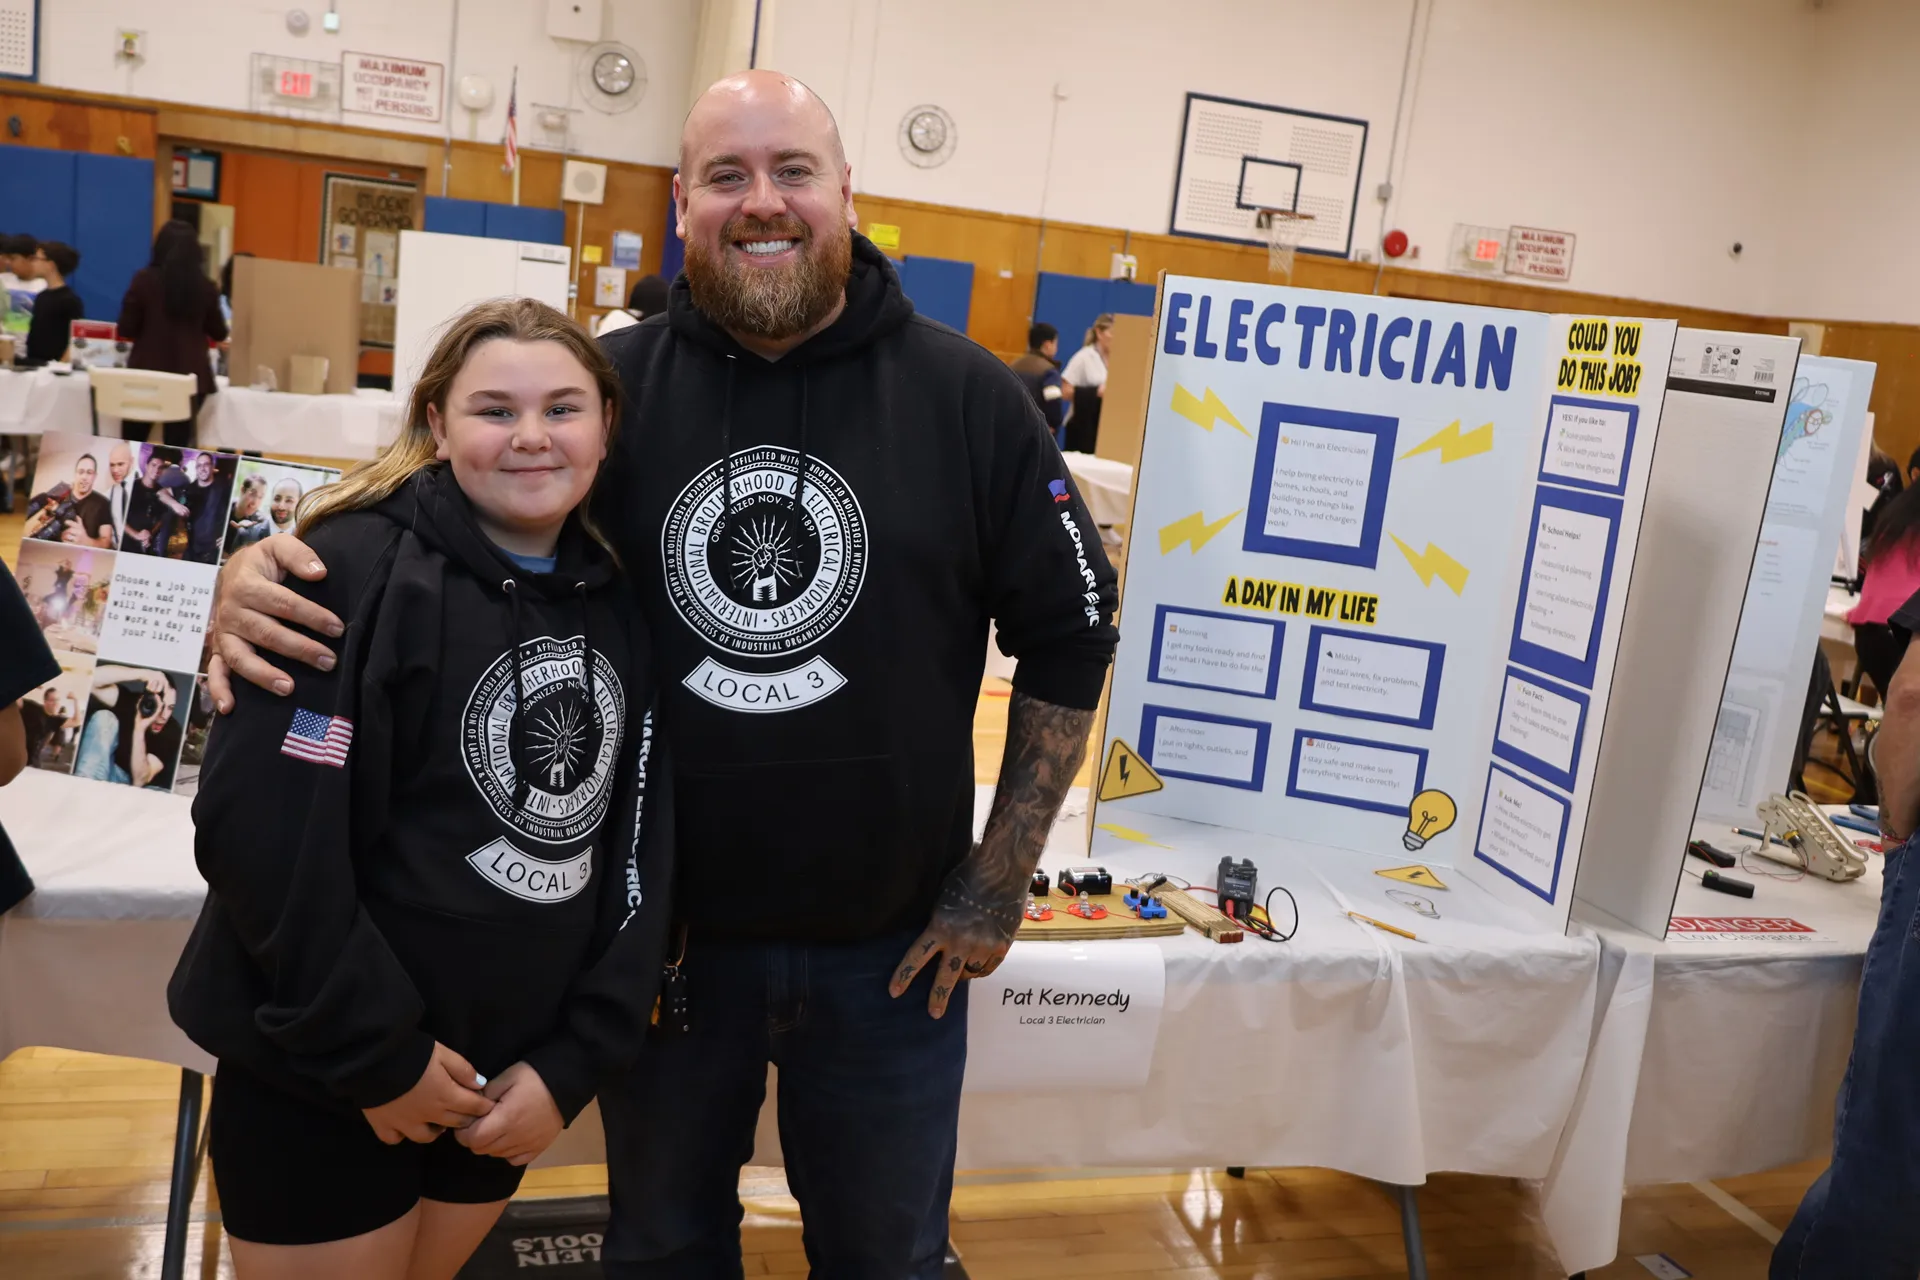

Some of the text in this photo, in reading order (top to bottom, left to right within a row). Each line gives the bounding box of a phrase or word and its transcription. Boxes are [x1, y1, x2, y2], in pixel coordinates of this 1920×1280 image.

[359, 59, 426, 77] MAXIMUM
[281, 71, 312, 97] EXIT
[353, 72, 430, 92] OCCUPANCY
[375, 99, 433, 117] PERSONS
[1163, 291, 1518, 392] ELECTRICIAN
[1568, 322, 1640, 356] COULD YOU
[1558, 359, 1640, 394] DO THIS JOB?
[730, 451, 800, 469] AFFILIATED WITH
[808, 463, 837, 487] LABOUR
[1279, 467, 1296, 478] help
[1298, 470, 1317, 481] bring
[1318, 474, 1355, 487] electricity
[1356, 478, 1364, 486] to
[683, 470, 717, 504] AMERICAN
[834, 486, 846, 497] OF
[1273, 480, 1348, 497] homes, schools, and
[1271, 493, 1305, 505] buildings
[1316, 500, 1339, 511] things
[1341, 502, 1354, 511] like
[758, 494, 783, 505] NOV.
[801, 514, 817, 537] 1891
[841, 497, 862, 548] FEDERATION
[1309, 512, 1324, 520] and
[1325, 514, 1357, 525] chargers
[667, 505, 686, 555] FEDERATION
[806, 493, 840, 572] ELECTRICAL
[667, 558, 675, 568] OF
[844, 552, 862, 595] CANADIAN
[115, 574, 149, 586] Choose
[168, 582, 185, 591] job
[191, 586, 210, 595] you
[669, 572, 684, 598] LABOR
[688, 541, 758, 628] INTERNATIONAL
[113, 600, 202, 620] will never have
[156, 594, 174, 602] and
[180, 597, 198, 606] you
[771, 578, 832, 628] WORKERS
[1225, 578, 1378, 623] A DAY IN MY LIFE
[108, 612, 119, 620] to
[125, 615, 148, 624] work
[166, 620, 184, 632] day
[191, 624, 202, 633] in
[122, 628, 146, 636] your
[685, 606, 718, 638] CONGRESS
[785, 604, 843, 648] ORGANIZATIONS
[719, 634, 730, 644] OF
[1178, 628, 1208, 640] Morning
[731, 638, 782, 651] INDUSTRIAL
[1170, 642, 1266, 661] get my tools ready and find
[1178, 655, 1197, 664] what
[1202, 658, 1219, 667] have
[1229, 661, 1239, 669] do
[1251, 665, 1264, 673] the
[1334, 652, 1362, 664] Midday
[1163, 666, 1177, 675] day
[1326, 667, 1349, 677] install
[1350, 670, 1371, 681] wires,
[1372, 673, 1382, 682] fix
[1383, 675, 1421, 688] problems,
[703, 670, 824, 704] LOCAL 3
[1336, 681, 1350, 689] test
[468, 676, 497, 725] FEDERATION
[467, 728, 477, 739] OF
[595, 686, 617, 767] ELECTRICAL
[467, 742, 482, 769] LABOR
[1162, 739, 1175, 747] put
[1234, 749, 1249, 757] and
[1315, 741, 1341, 752] All Day
[1307, 756, 1323, 765] stay
[1323, 757, 1339, 766] safe
[1340, 760, 1354, 768] and
[1355, 763, 1376, 772] make
[1302, 768, 1400, 789] everything works correctly!
[483, 780, 513, 818] CONGRESS
[514, 815, 525, 826] OF
[565, 798, 607, 837] ORGANIZATIONS
[526, 821, 564, 838] INDUSTRIAL
[490, 852, 588, 893] LOCAL 3
[1670, 918, 1804, 931] DANGER
[1001, 987, 1131, 1013] Pat Kennedy
[1019, 1015, 1106, 1025] Local 3 Electrician
[512, 1233, 604, 1253] OOLS
[517, 1246, 601, 1268] LEIN
